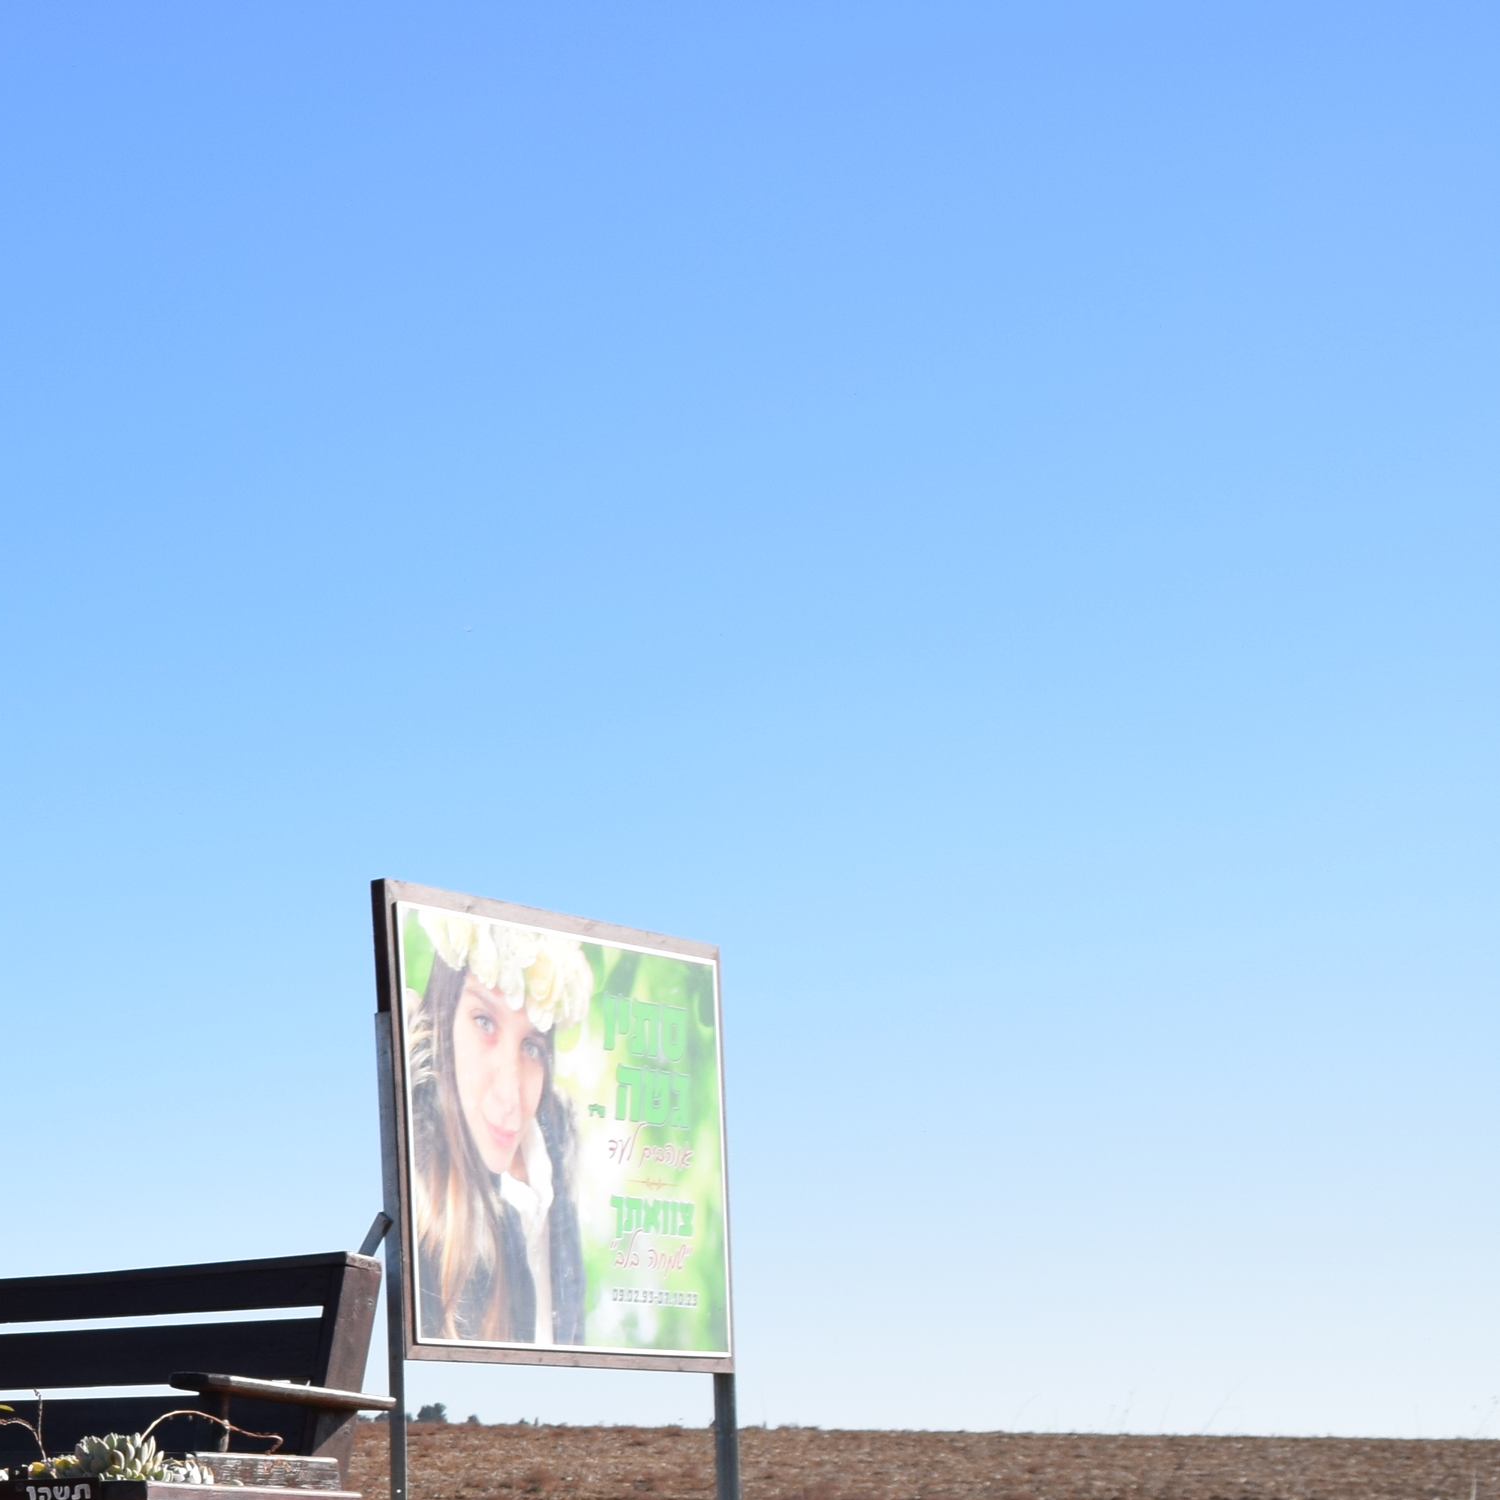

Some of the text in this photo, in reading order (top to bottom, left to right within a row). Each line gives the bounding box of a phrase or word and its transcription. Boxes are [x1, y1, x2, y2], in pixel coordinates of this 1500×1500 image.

[608, 1123, 693, 1169] אוהבים לעד
[610, 1194, 695, 1238] צוואתך
